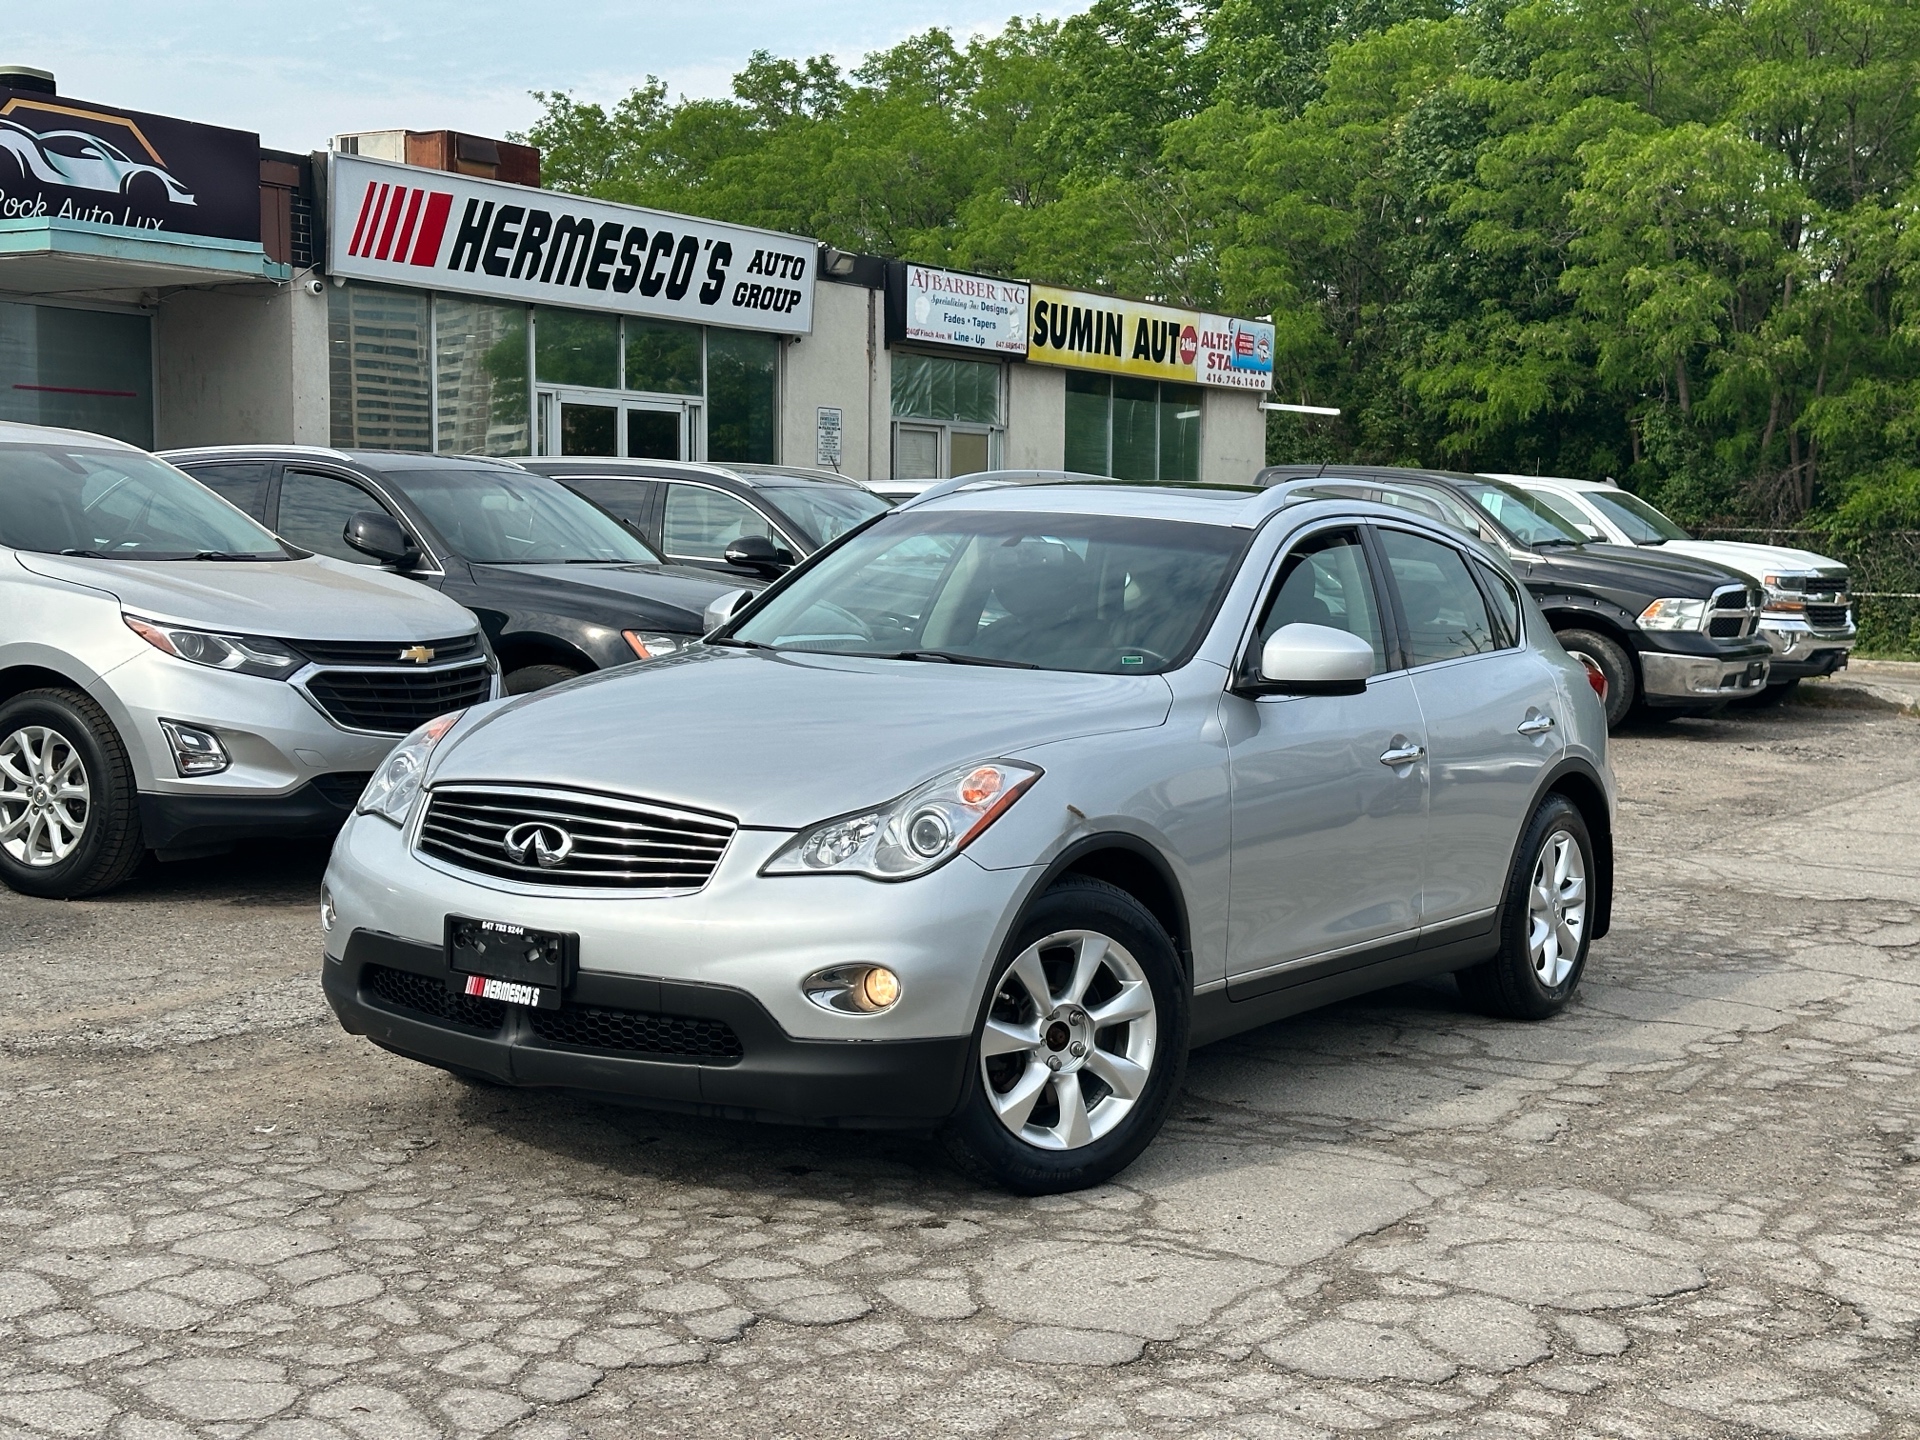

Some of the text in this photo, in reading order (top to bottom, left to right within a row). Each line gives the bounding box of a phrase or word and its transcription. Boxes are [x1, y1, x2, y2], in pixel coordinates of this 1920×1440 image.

[447, 198, 732, 305] HERMESCO'S
[746, 249, 806, 282] AUTO
[732, 281, 803, 313] GROUP
[981, 301, 1009, 316] Designs
[943, 313, 997, 331] Fades Tapers
[1033, 300, 1123, 357] SUMIN
[920, 330, 935, 338] Finch
[953, 331, 970, 343] Line
[975, 335, 986, 346] Up
[1181, 336, 1197, 352] 24hr
[1206, 373, 1266, 389] 416.746.1400
[482, 921, 494, 930] 647
[507, 926, 524, 935] 9244
[482, 979, 540, 1007] HERMESCO'S
